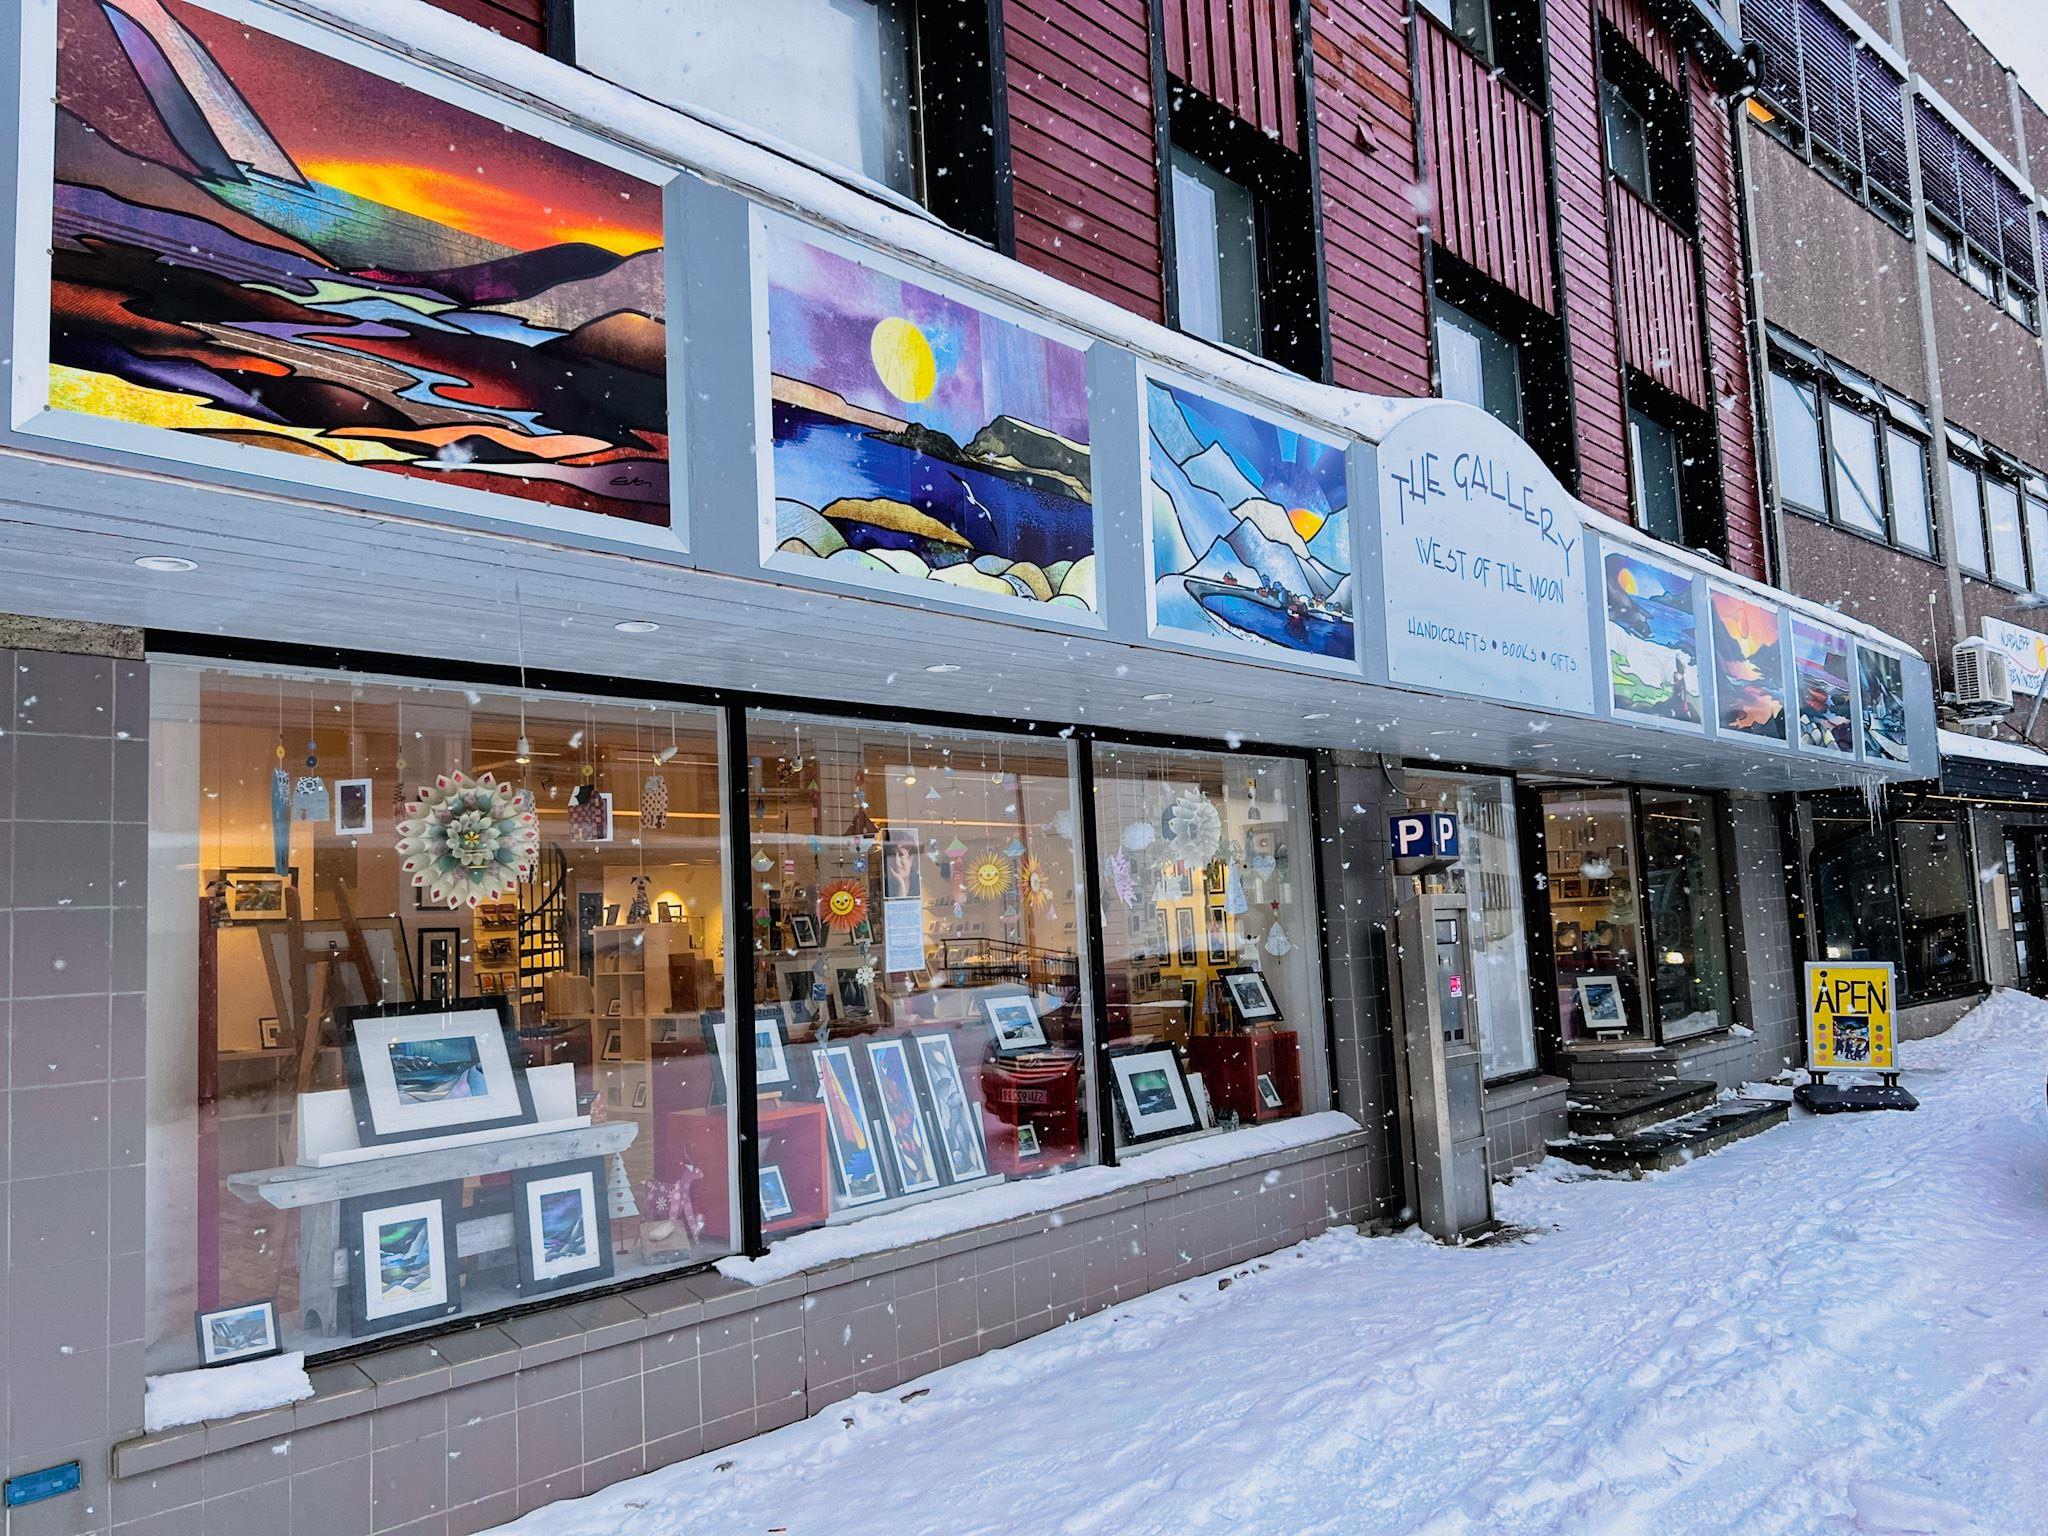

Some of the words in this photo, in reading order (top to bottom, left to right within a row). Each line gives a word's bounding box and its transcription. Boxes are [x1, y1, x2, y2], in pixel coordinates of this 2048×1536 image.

[1391, 452, 1446, 525] THE
[1453, 453, 1575, 577] GALLERY
[1415, 537, 1467, 581] WEST
[1473, 556, 1491, 589] OF
[1496, 563, 1526, 594] THE
[1529, 573, 1565, 605] MOON
[1407, 616, 1488, 652] HANDICRAFTS
[1501, 641, 1537, 664] BOOKS
[1550, 654, 1577, 672] GIFTS
[1398, 819, 1424, 855] P
[1439, 817, 1454, 853] P
[1814, 970, 1887, 1015] ÅPEN
